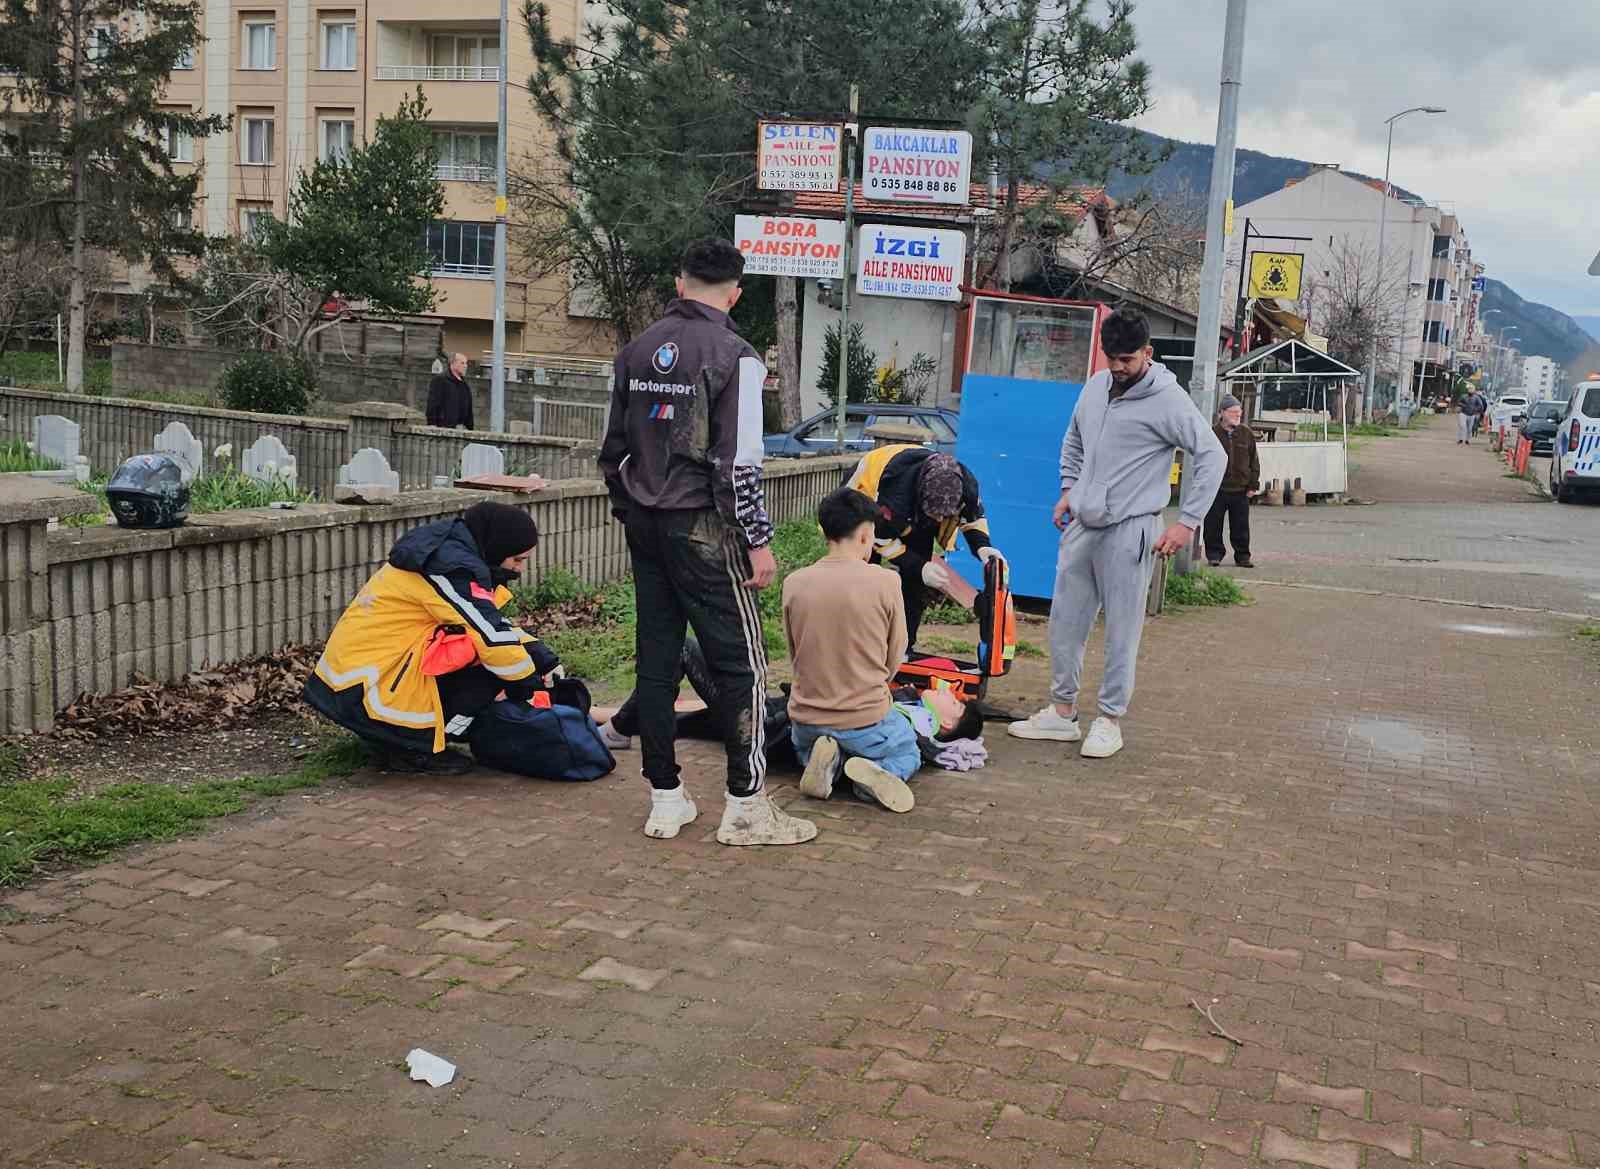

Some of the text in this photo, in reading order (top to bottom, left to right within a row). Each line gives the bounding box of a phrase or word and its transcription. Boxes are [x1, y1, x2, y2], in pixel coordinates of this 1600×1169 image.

[765, 125, 836, 142] SELEN
[874, 134, 958, 154] BAKCAKLAR
[761, 170, 767, 178] 0
[868, 154, 960, 178] PANSİYON
[871, 178, 957, 193] 0 535 848 88 86
[763, 220, 817, 238] BORA
[739, 238, 841, 259] PANSİYON
[874, 230, 940, 258] İZGİ
[863, 256, 889, 278] AİLE
[891, 260, 953, 283] PANSİYONU
[629, 378, 697, 396] Motorsport
